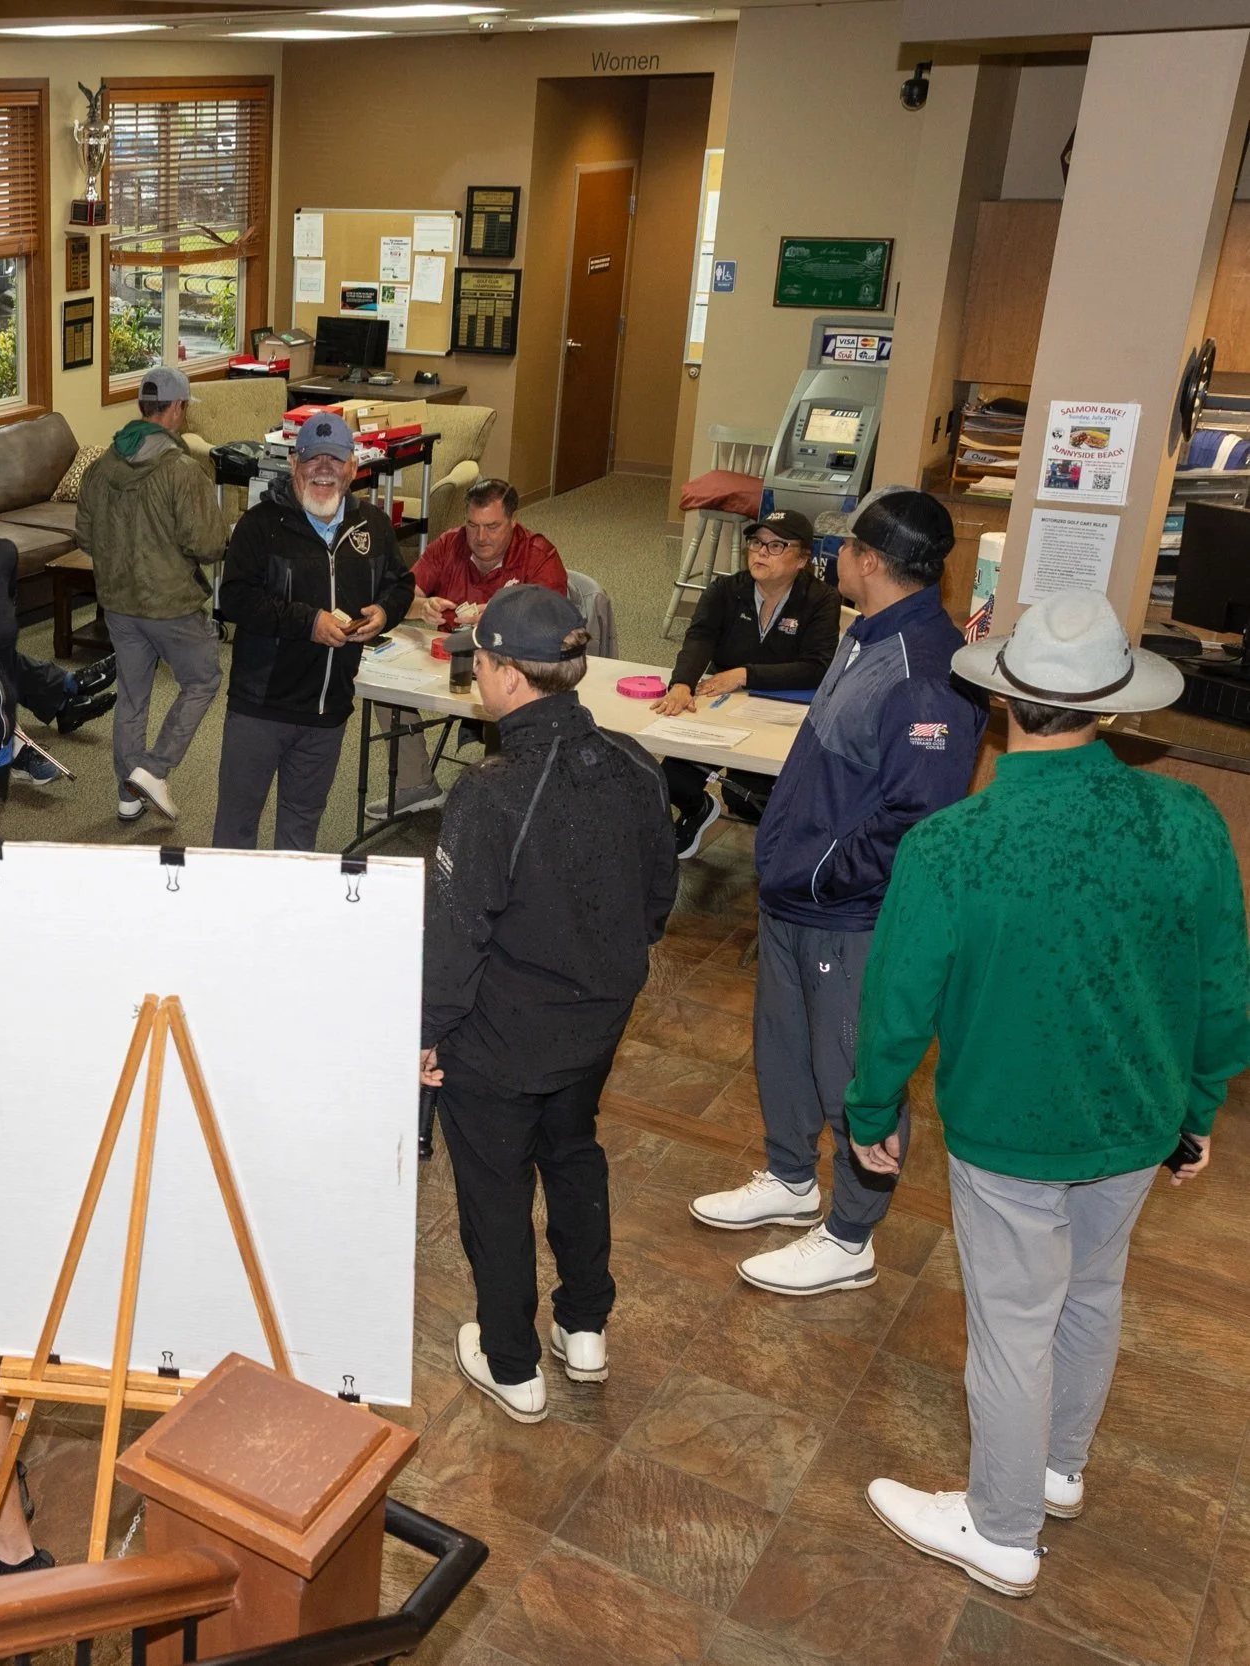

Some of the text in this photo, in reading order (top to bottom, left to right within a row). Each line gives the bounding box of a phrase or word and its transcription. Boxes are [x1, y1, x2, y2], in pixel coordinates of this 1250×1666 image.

[591, 51, 660, 71] Women
[1060, 406, 1127, 418] SALMON BAKE!
[971, 453, 987, 461] Out
[1052, 444, 1125, 459] SUNNYSIDE BEACH
